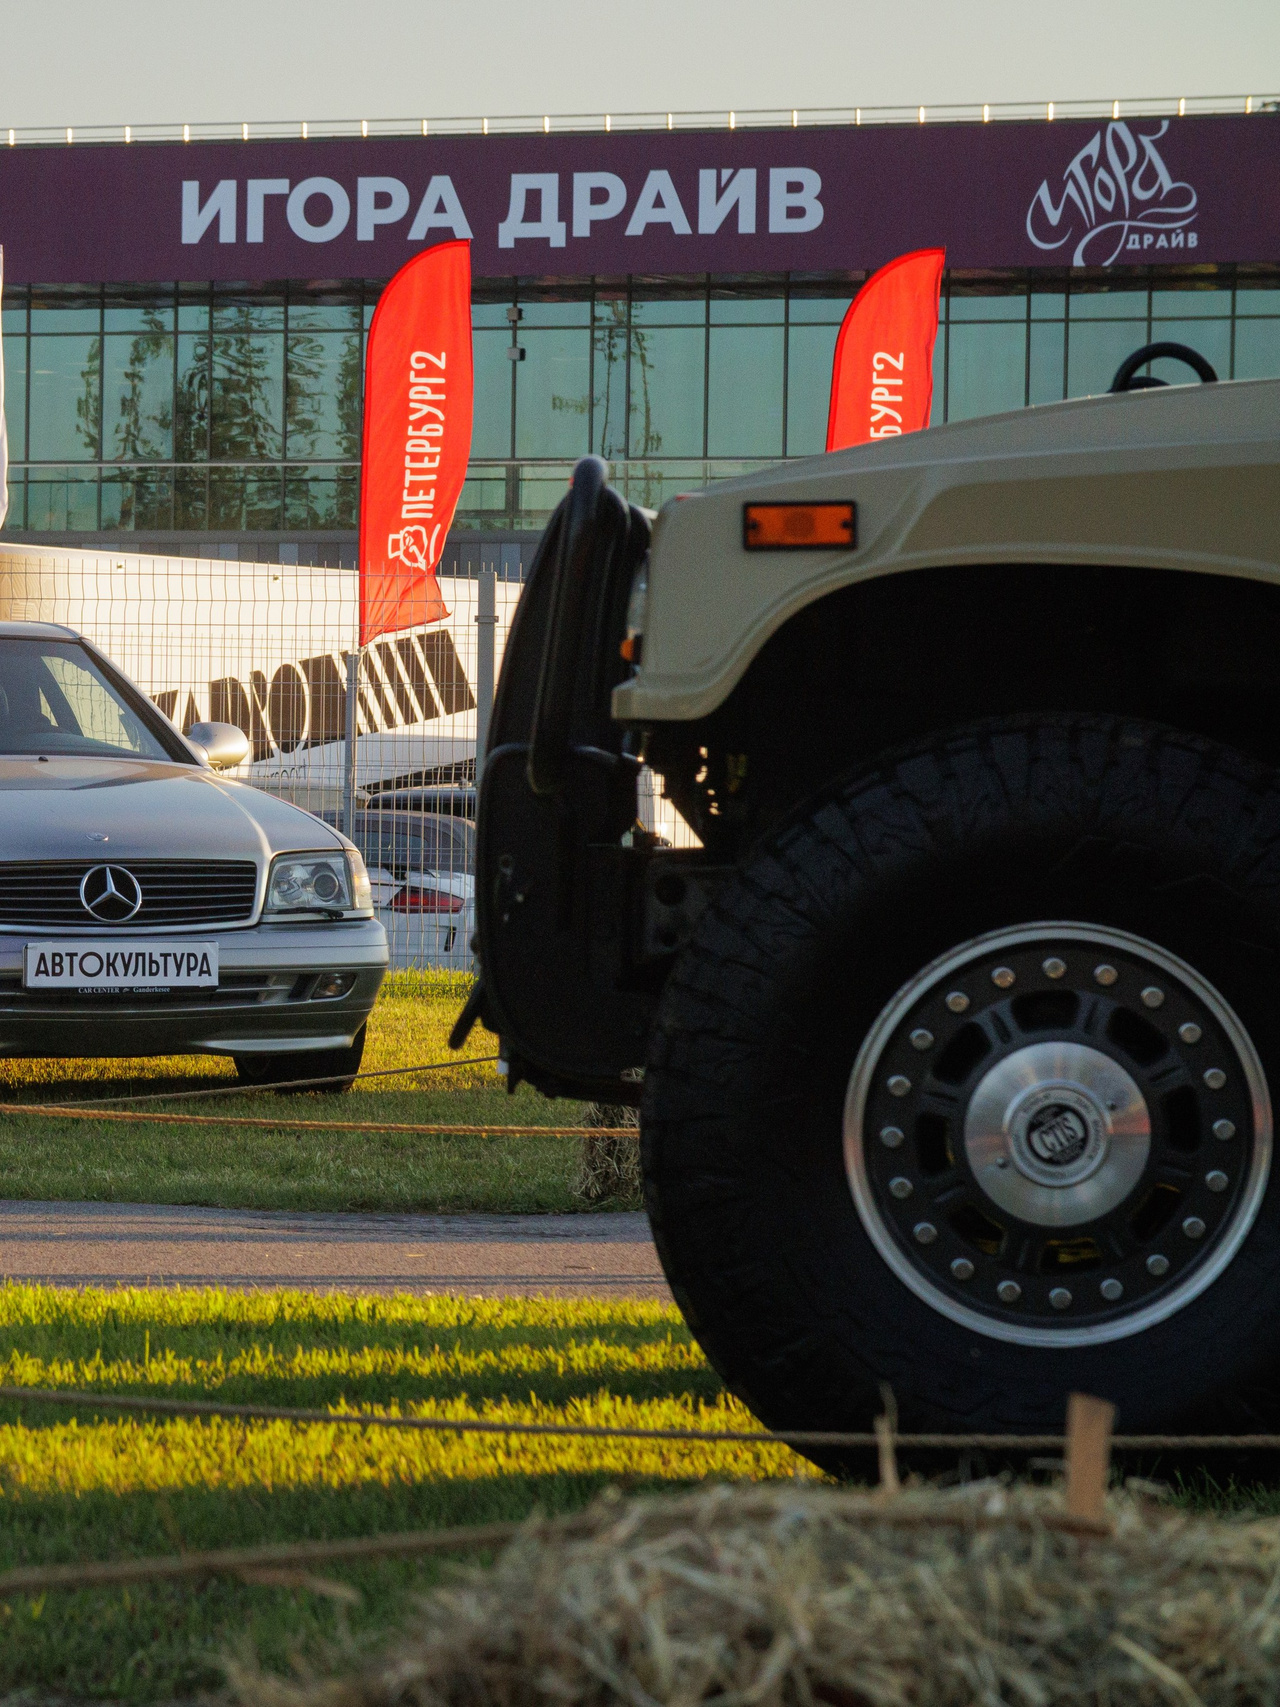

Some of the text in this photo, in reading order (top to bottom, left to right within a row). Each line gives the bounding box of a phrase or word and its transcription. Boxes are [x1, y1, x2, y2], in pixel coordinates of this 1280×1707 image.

[181, 167, 824, 248] ИГОРА ДРАЙВ
[1126, 229, 1199, 249] ДРАЙВ
[401, 350, 446, 519] ПЕТЕРБУРГ2
[34, 951, 212, 977] АВТОКУЛЬТУРА
